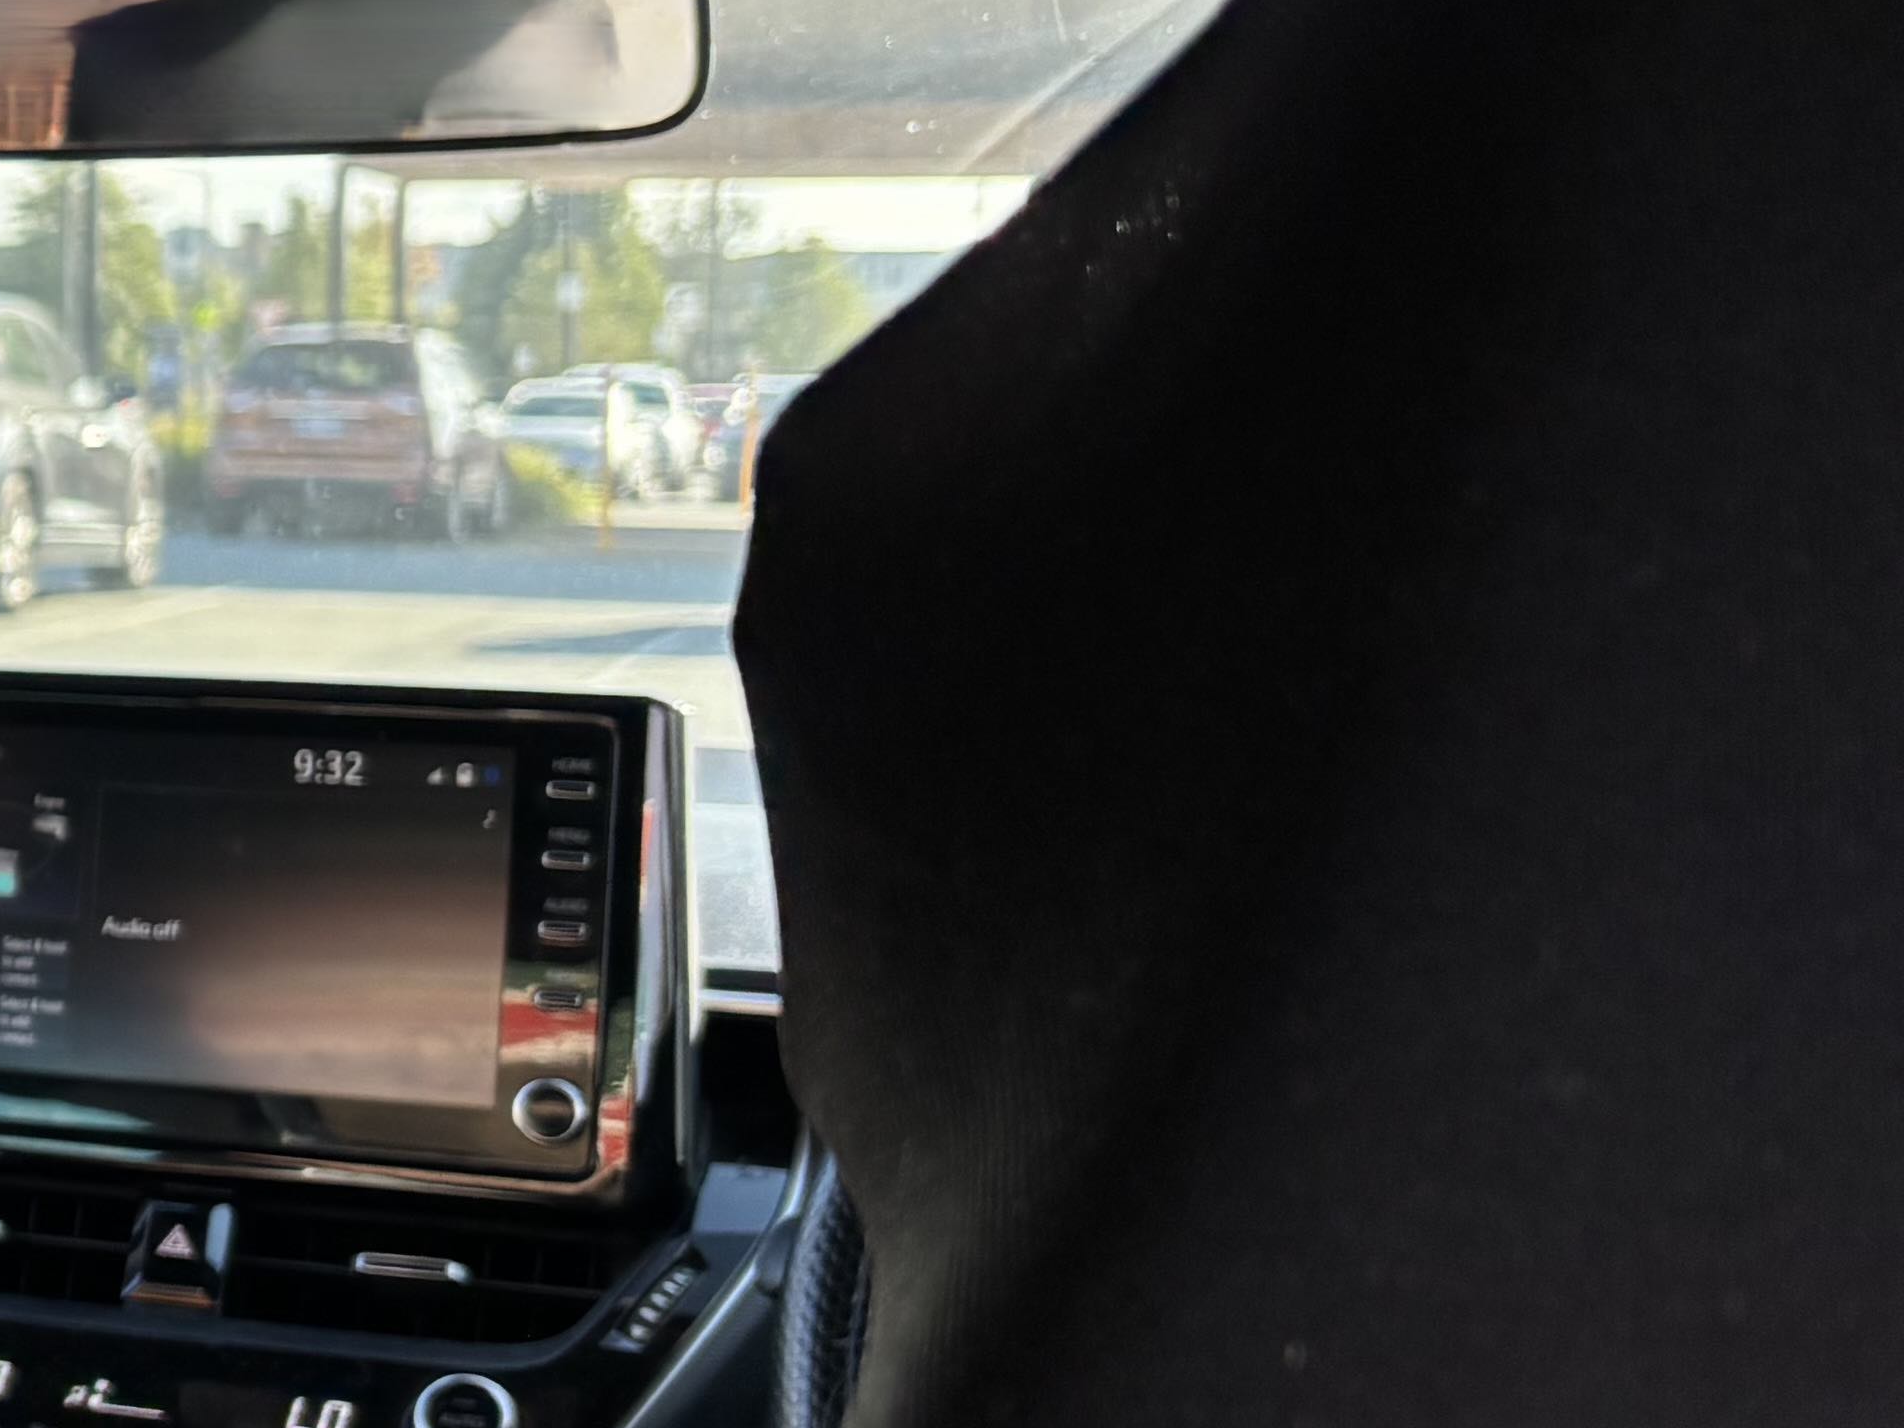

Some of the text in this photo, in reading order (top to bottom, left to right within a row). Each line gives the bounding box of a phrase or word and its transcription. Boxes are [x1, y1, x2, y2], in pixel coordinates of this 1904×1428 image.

[293, 747, 367, 787] 9:32
[101, 914, 182, 942] Audio off
